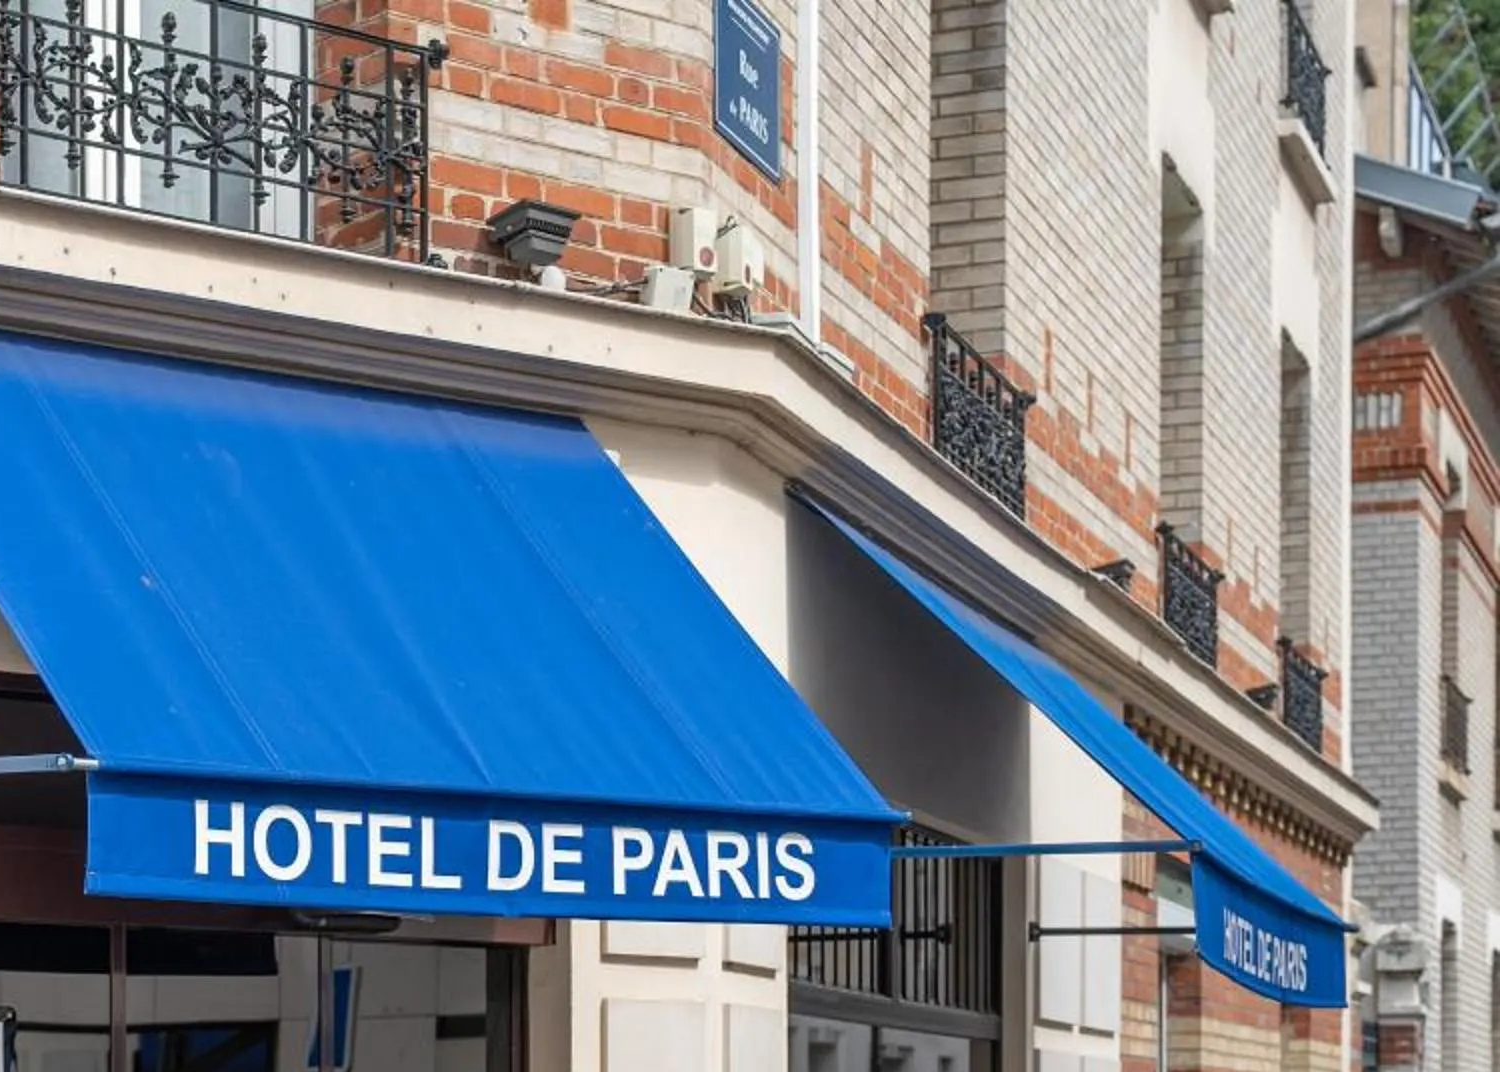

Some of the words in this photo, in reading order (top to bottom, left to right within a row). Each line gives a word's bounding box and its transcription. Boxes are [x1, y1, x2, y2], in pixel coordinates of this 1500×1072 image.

[739, 49, 760, 91] Rue
[739, 95, 769, 145] PARIS
[195, 800, 461, 889] HOTEL
[487, 821, 585, 893] DE
[612, 827, 815, 901] PARIS
[1223, 907, 1256, 975] HOTEL
[1257, 928, 1271, 982] DE
[1272, 936, 1308, 992] PARIS
